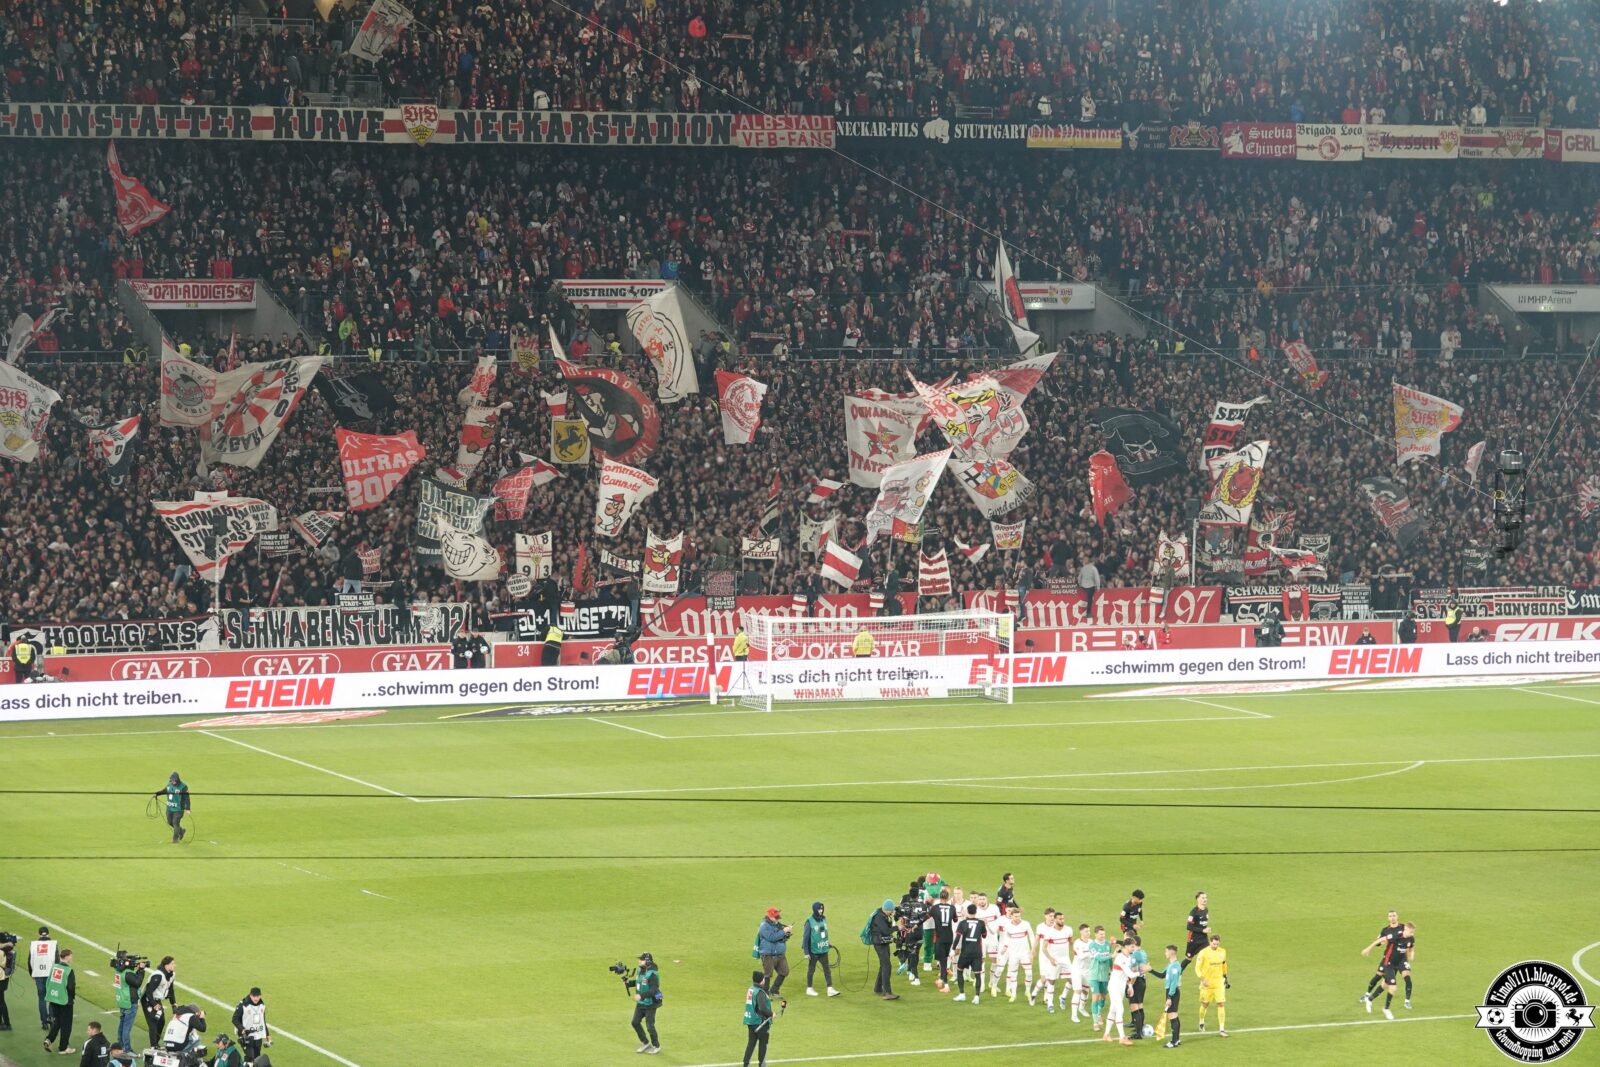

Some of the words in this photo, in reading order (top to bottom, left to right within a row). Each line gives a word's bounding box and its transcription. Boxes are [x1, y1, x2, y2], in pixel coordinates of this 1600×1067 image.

[273, 107, 384, 141] KURVE
[454, 111, 732, 144] NECKARSTADION
[740, 115, 835, 131] ALBSTADT
[836, 121, 918, 140] NECKAR-FILS
[954, 123, 1027, 139] STUTTGART
[1028, 123, 1053, 141] Old
[1058, 123, 1121, 141] Warriors
[1297, 125, 1336, 137] Brigada
[742, 131, 833, 148] VFB-FANS
[1248, 127, 1293, 139] Suebia
[153, 285, 179, 299] 0711
[182, 284, 235, 300] ADDICTS
[342, 450, 419, 478] ULTRAS
[523, 565, 531, 577] 9
[543, 565, 549, 577] 3
[1174, 589, 1215, 625] 97
[227, 606, 424, 648] SCHWABENSTURM
[518, 608, 551, 632] 50+1
[1420, 623, 1431, 633] 36
[966, 633, 978, 644] 35
[517, 645, 530, 656] 34
[1446, 653, 1480, 666] Lass
[1483, 651, 1512, 665] dich
[1516, 650, 1549, 664] nicht
[1091, 659, 1175, 675] ...schwimm
[1178, 661, 1224, 676] gegen
[1228, 655, 1254, 671] den
[1258, 655, 1306, 671] Strom!
[1328, 647, 1423, 675] EHEIM
[799, 668, 831, 684] dich
[834, 667, 873, 682] nicht
[968, 656, 1067, 686] EHEIM
[361, 677, 453, 697] ...schwimm
[458, 680, 508, 698] gegen
[513, 676, 541, 692] den
[547, 675, 600, 691] Strom!
[627, 666, 732, 696] EHEIM
[0, 696, 30, 710] ass
[35, 693, 71, 708] dich
[77, 691, 118, 707] nicht
[123, 690, 198, 706] treiben...
[225, 677, 335, 709] EHEIM
[793, 688, 844, 699] WINAMAX
[879, 687, 930, 698] WINAMAX
[941, 908, 950, 920] 11
[968, 924, 976, 939] 7
